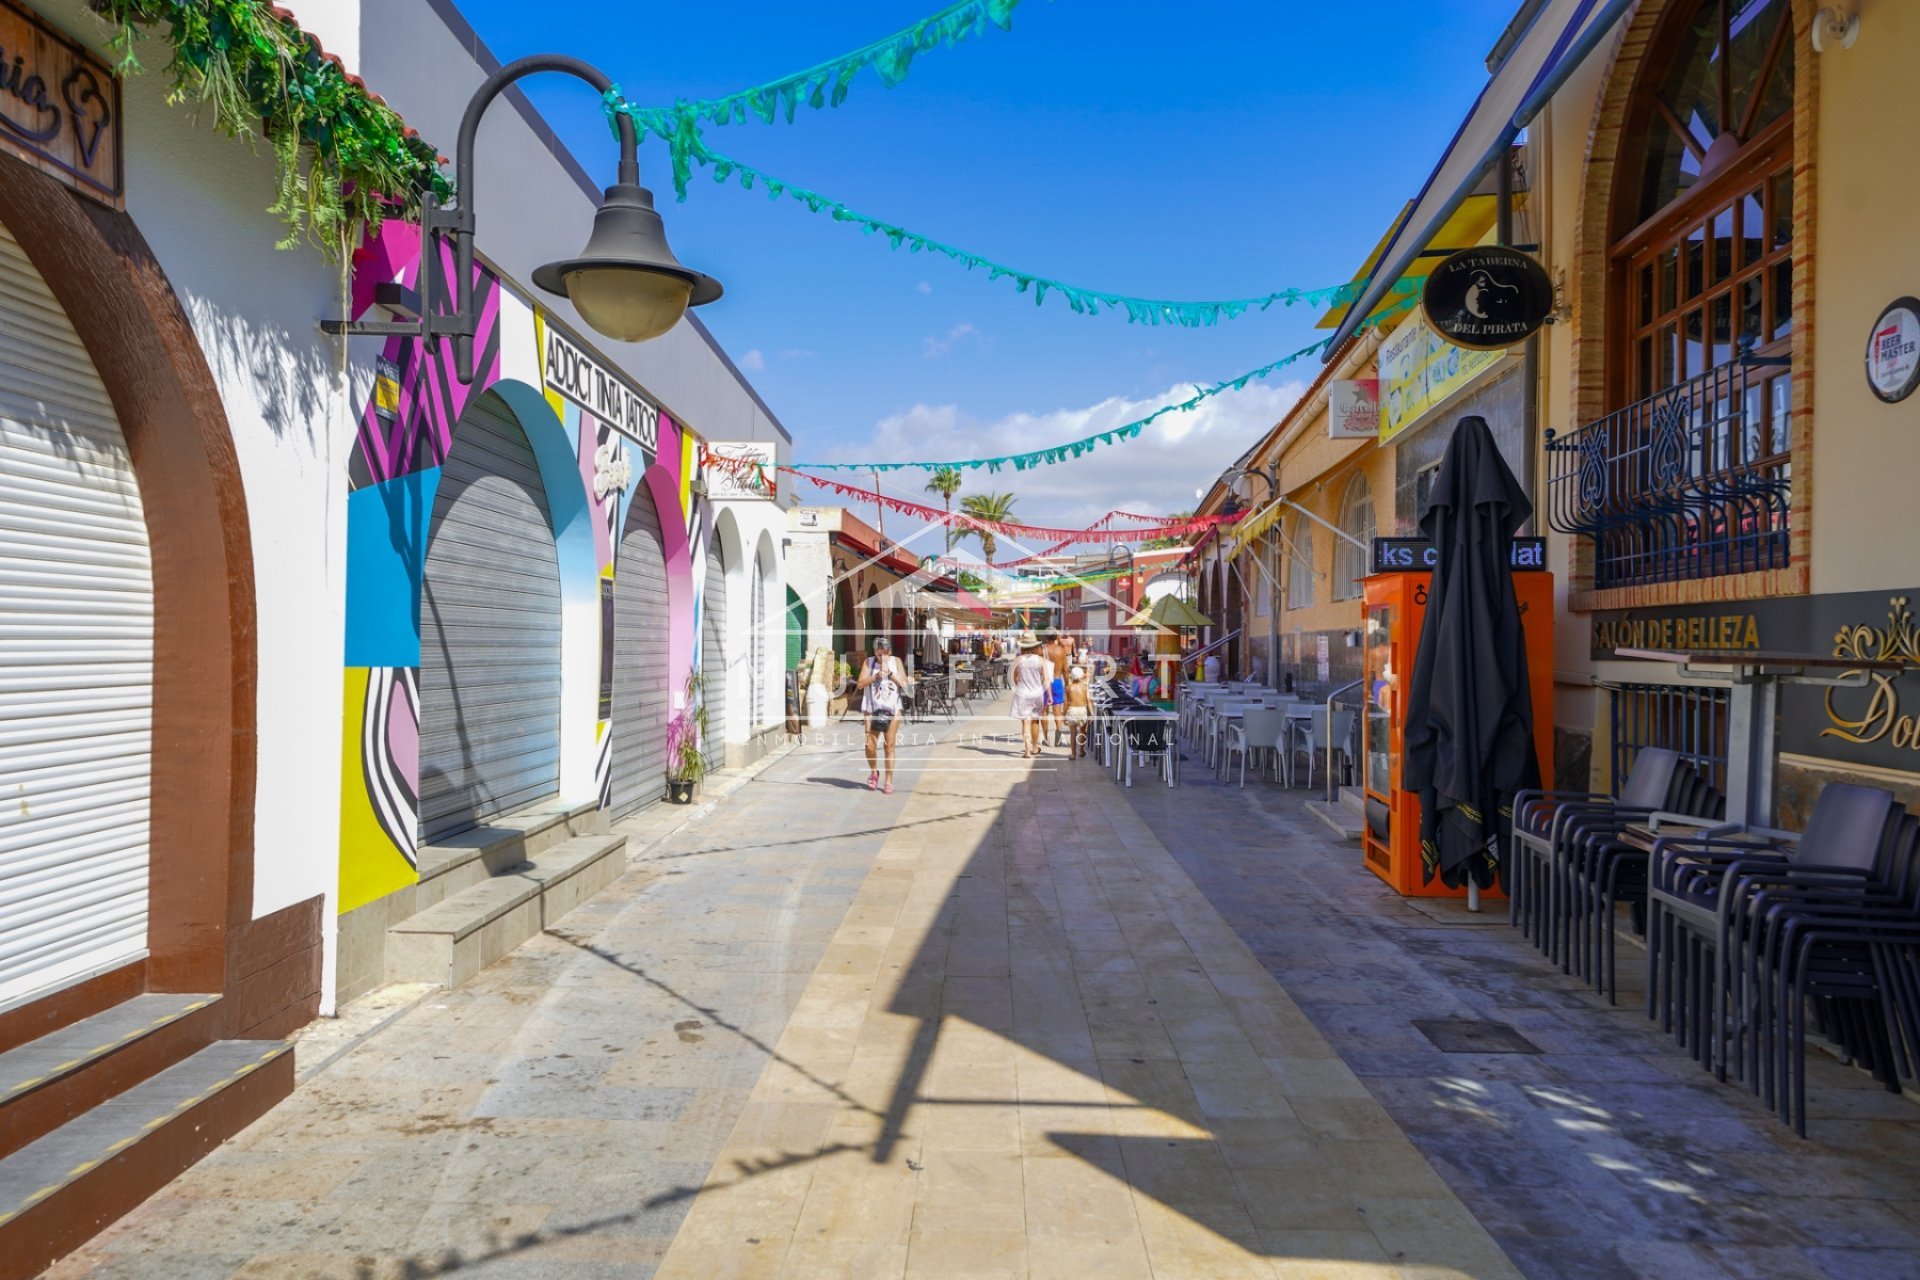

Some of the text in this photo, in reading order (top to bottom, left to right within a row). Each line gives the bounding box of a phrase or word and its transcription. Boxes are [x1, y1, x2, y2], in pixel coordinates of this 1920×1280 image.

[1448, 256, 1528, 272] LA TABERNA
[1453, 322, 1529, 335] DEL PIRATA
[1880, 340, 1917, 363] MASTER
[1881, 334, 1902, 351] BEER
[546, 330, 657, 448] ADDICT TINTA TATTOO
[1383, 541, 1413, 565] ks
[1592, 611, 1761, 649] SALÓN DE BELLEZA
